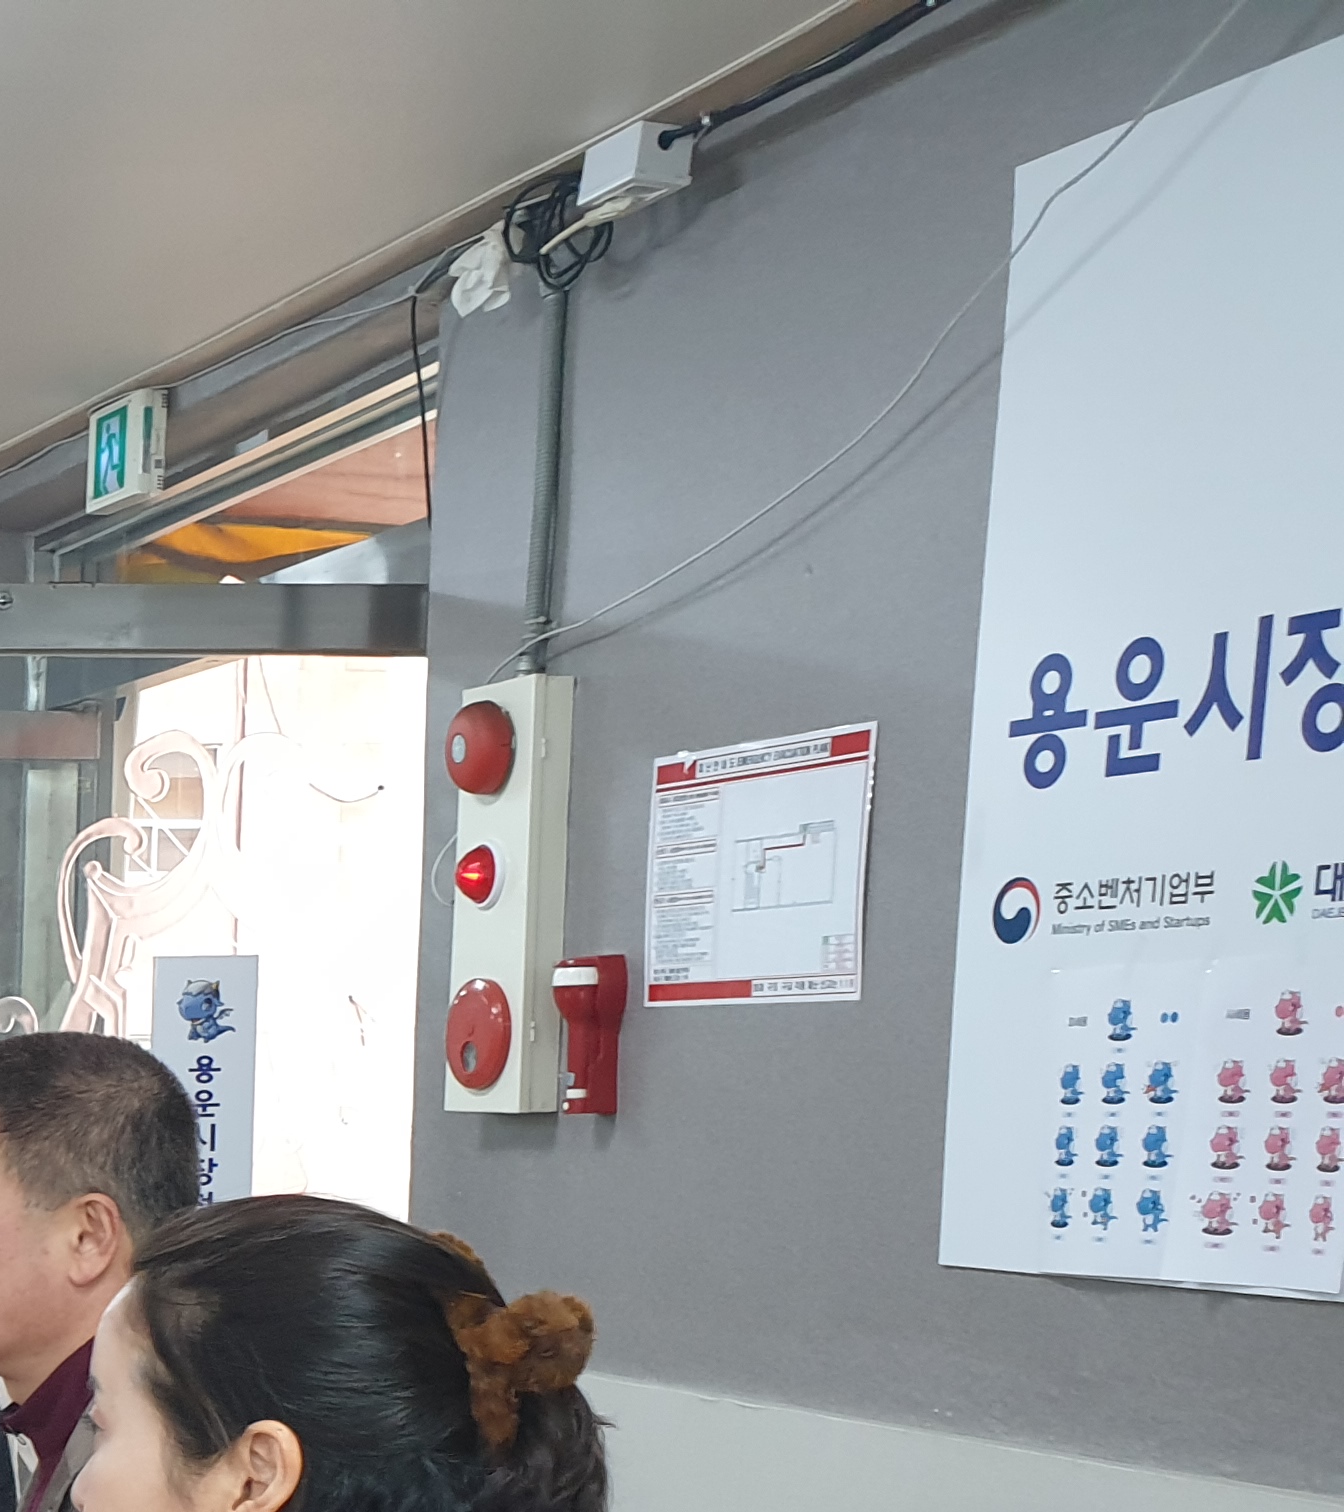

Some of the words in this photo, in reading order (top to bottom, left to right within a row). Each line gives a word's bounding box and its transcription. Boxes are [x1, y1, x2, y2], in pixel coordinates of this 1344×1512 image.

[1053, 870, 1215, 914] 중소벤처기업부
[1094, 920, 1105, 933] of
[1108, 919, 1136, 932] SMEs
[1139, 917, 1160, 929] and
[1163, 916, 1211, 929] Startups
